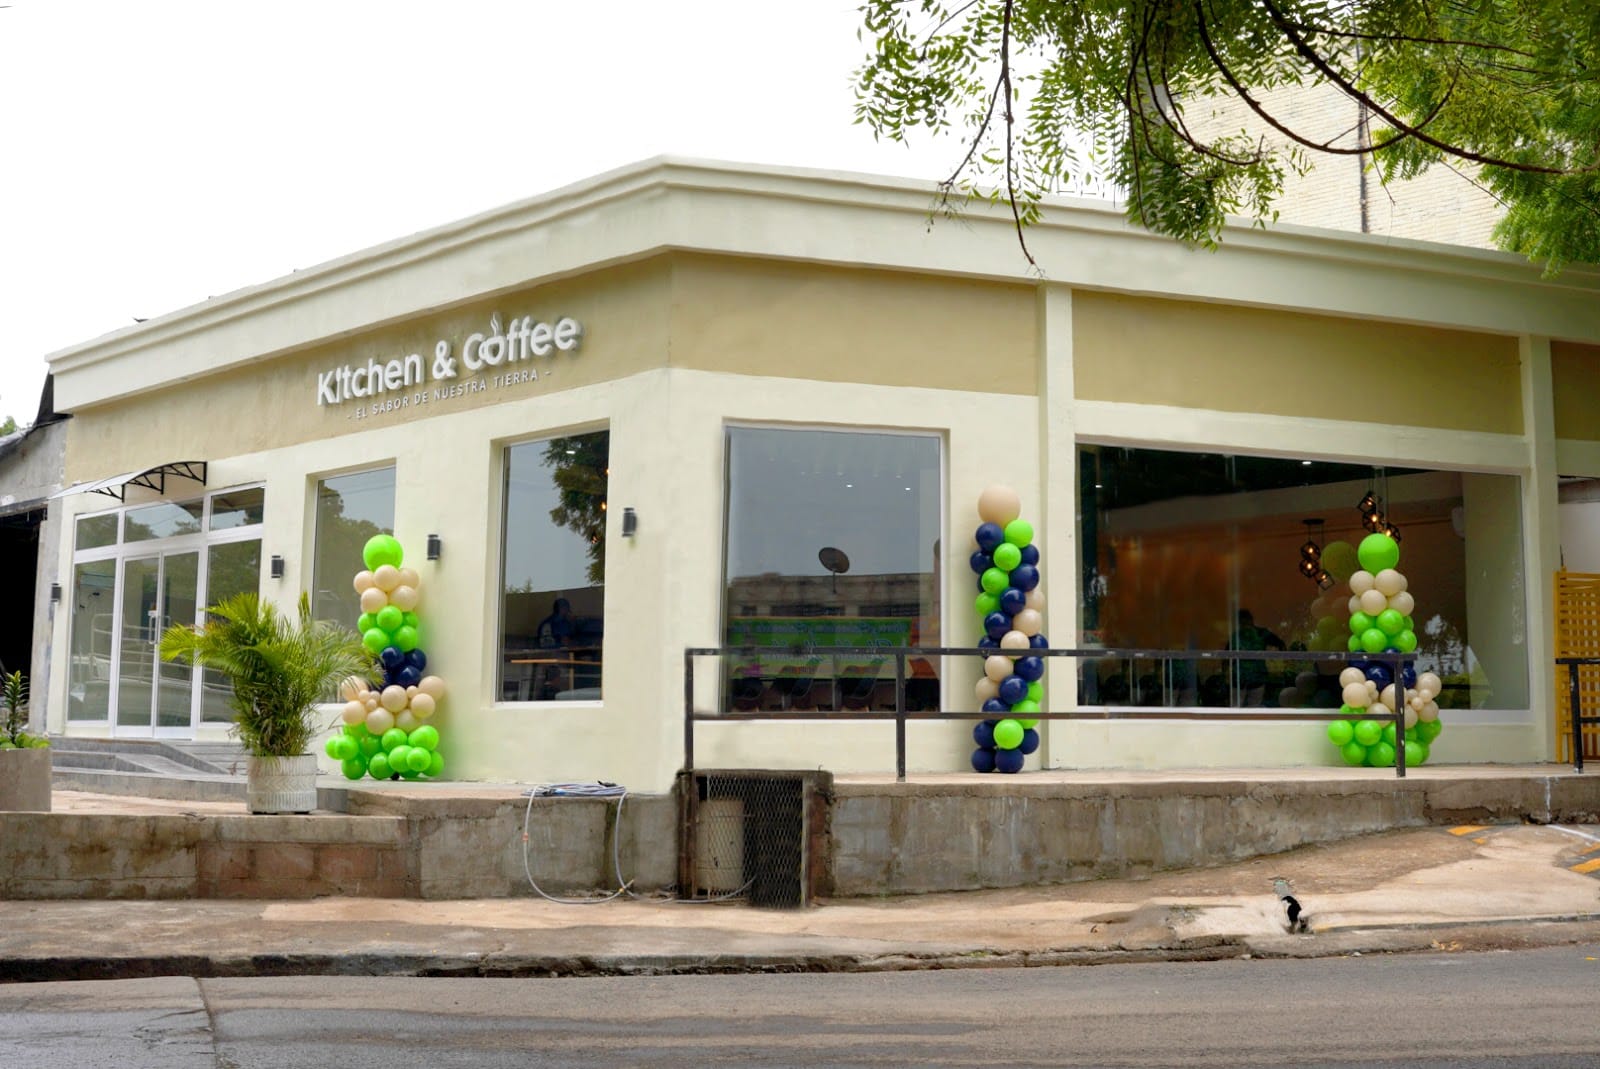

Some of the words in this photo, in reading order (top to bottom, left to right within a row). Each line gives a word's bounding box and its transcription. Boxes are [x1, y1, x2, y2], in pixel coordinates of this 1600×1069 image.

[432, 340, 457, 380] &
[463, 312, 580, 371] Coffee
[356, 407, 368, 420] EL
[372, 399, 410, 415] SABOR
[414, 392, 429, 405] DE
[433, 381, 488, 401] NUESTRA
[493, 368, 539, 388] TIERRA
